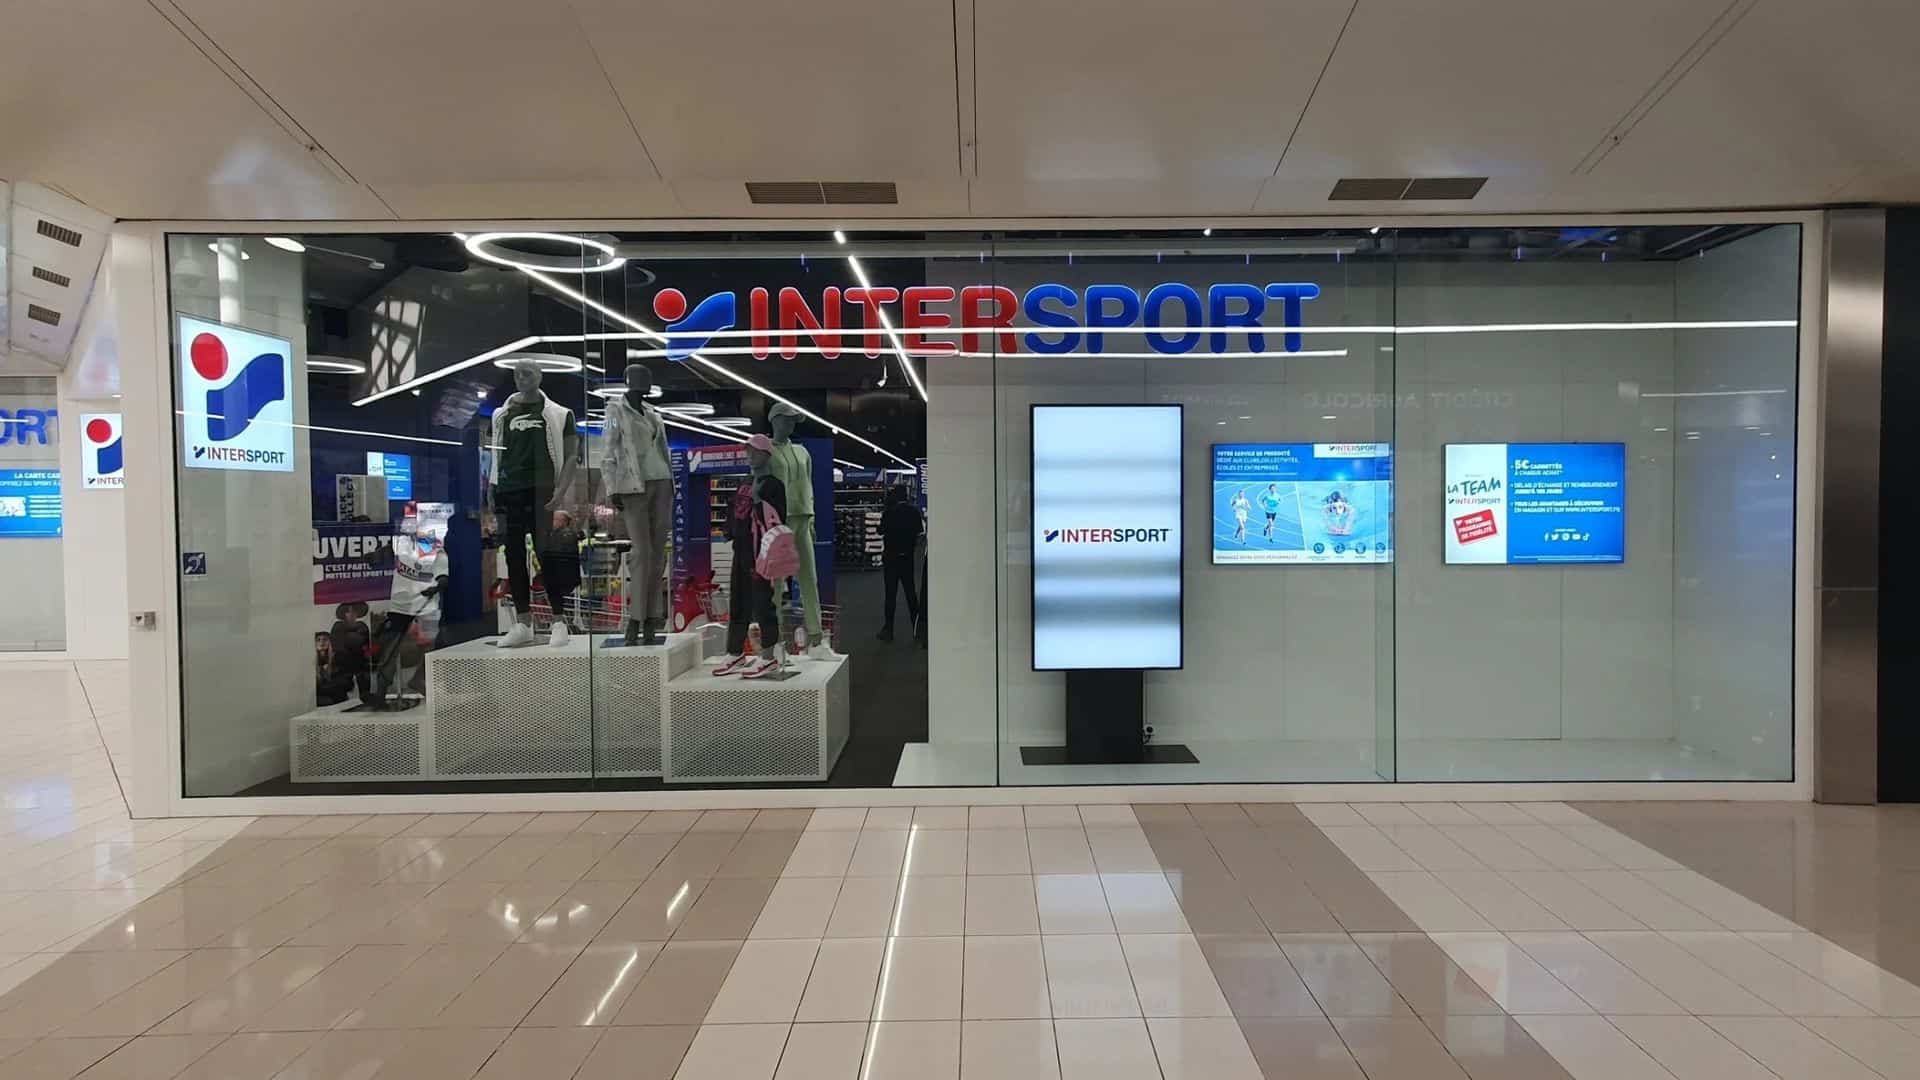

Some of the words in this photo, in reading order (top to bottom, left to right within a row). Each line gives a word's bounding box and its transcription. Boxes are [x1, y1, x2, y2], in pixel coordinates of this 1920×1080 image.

[749, 283, 1320, 361] INTERSPORT
[207, 446, 287, 464] INTERSPORT
[1448, 484, 1459, 494] LA
[1460, 476, 1501, 496] TEAM
[1455, 497, 1501, 505] INTERSPORT
[1061, 528, 1169, 543] INTERSPORT
